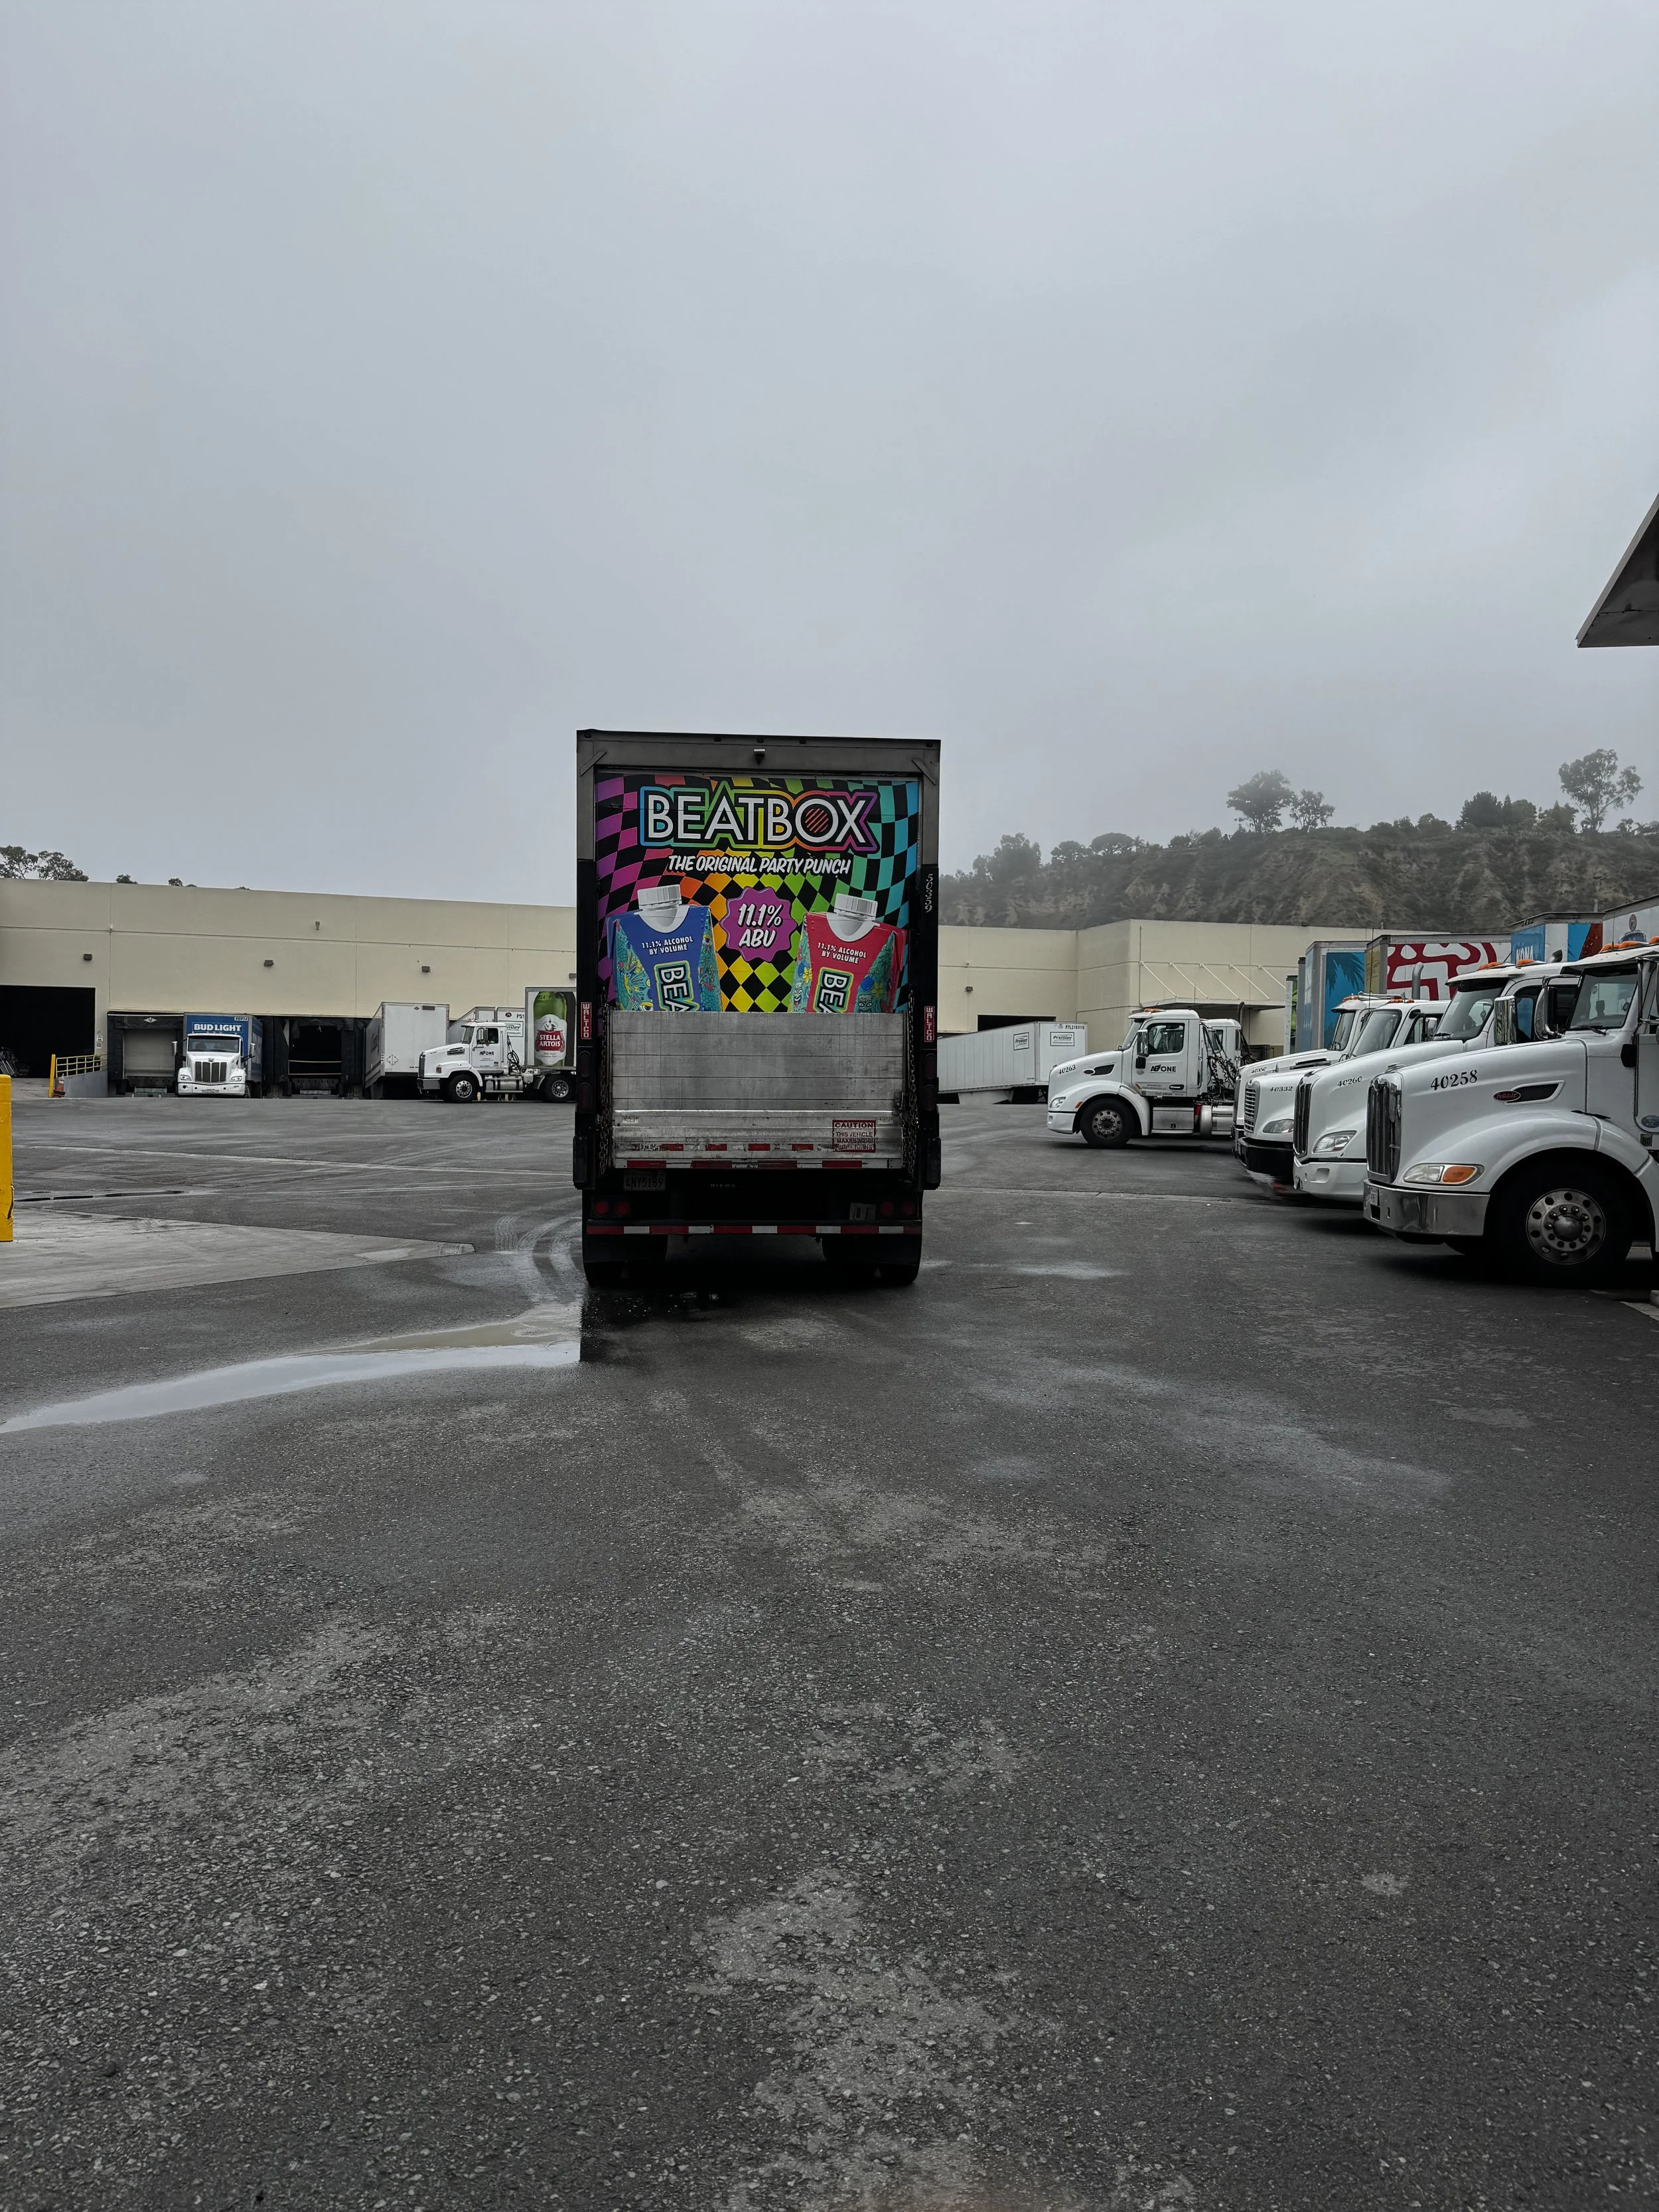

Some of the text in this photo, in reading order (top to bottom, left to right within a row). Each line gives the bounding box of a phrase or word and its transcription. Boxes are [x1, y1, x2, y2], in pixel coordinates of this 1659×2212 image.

[647, 794, 867, 844] BEATBOX
[668, 855, 852, 875] THE ORIGINAL PARTY PUNCH
[737, 903, 782, 926] 11.1%
[641, 936, 693, 949] 11.1% ALCOHOL
[660, 944, 688, 954] VOLUME
[817, 942, 867, 958] 11.1% ALCOHOL
[832, 952, 859, 964] VOLUME
[1058, 1064, 1076, 1074] 40263
[1337, 1076, 1362, 1087] 40260
[1430, 1069, 1478, 1091] 40258
